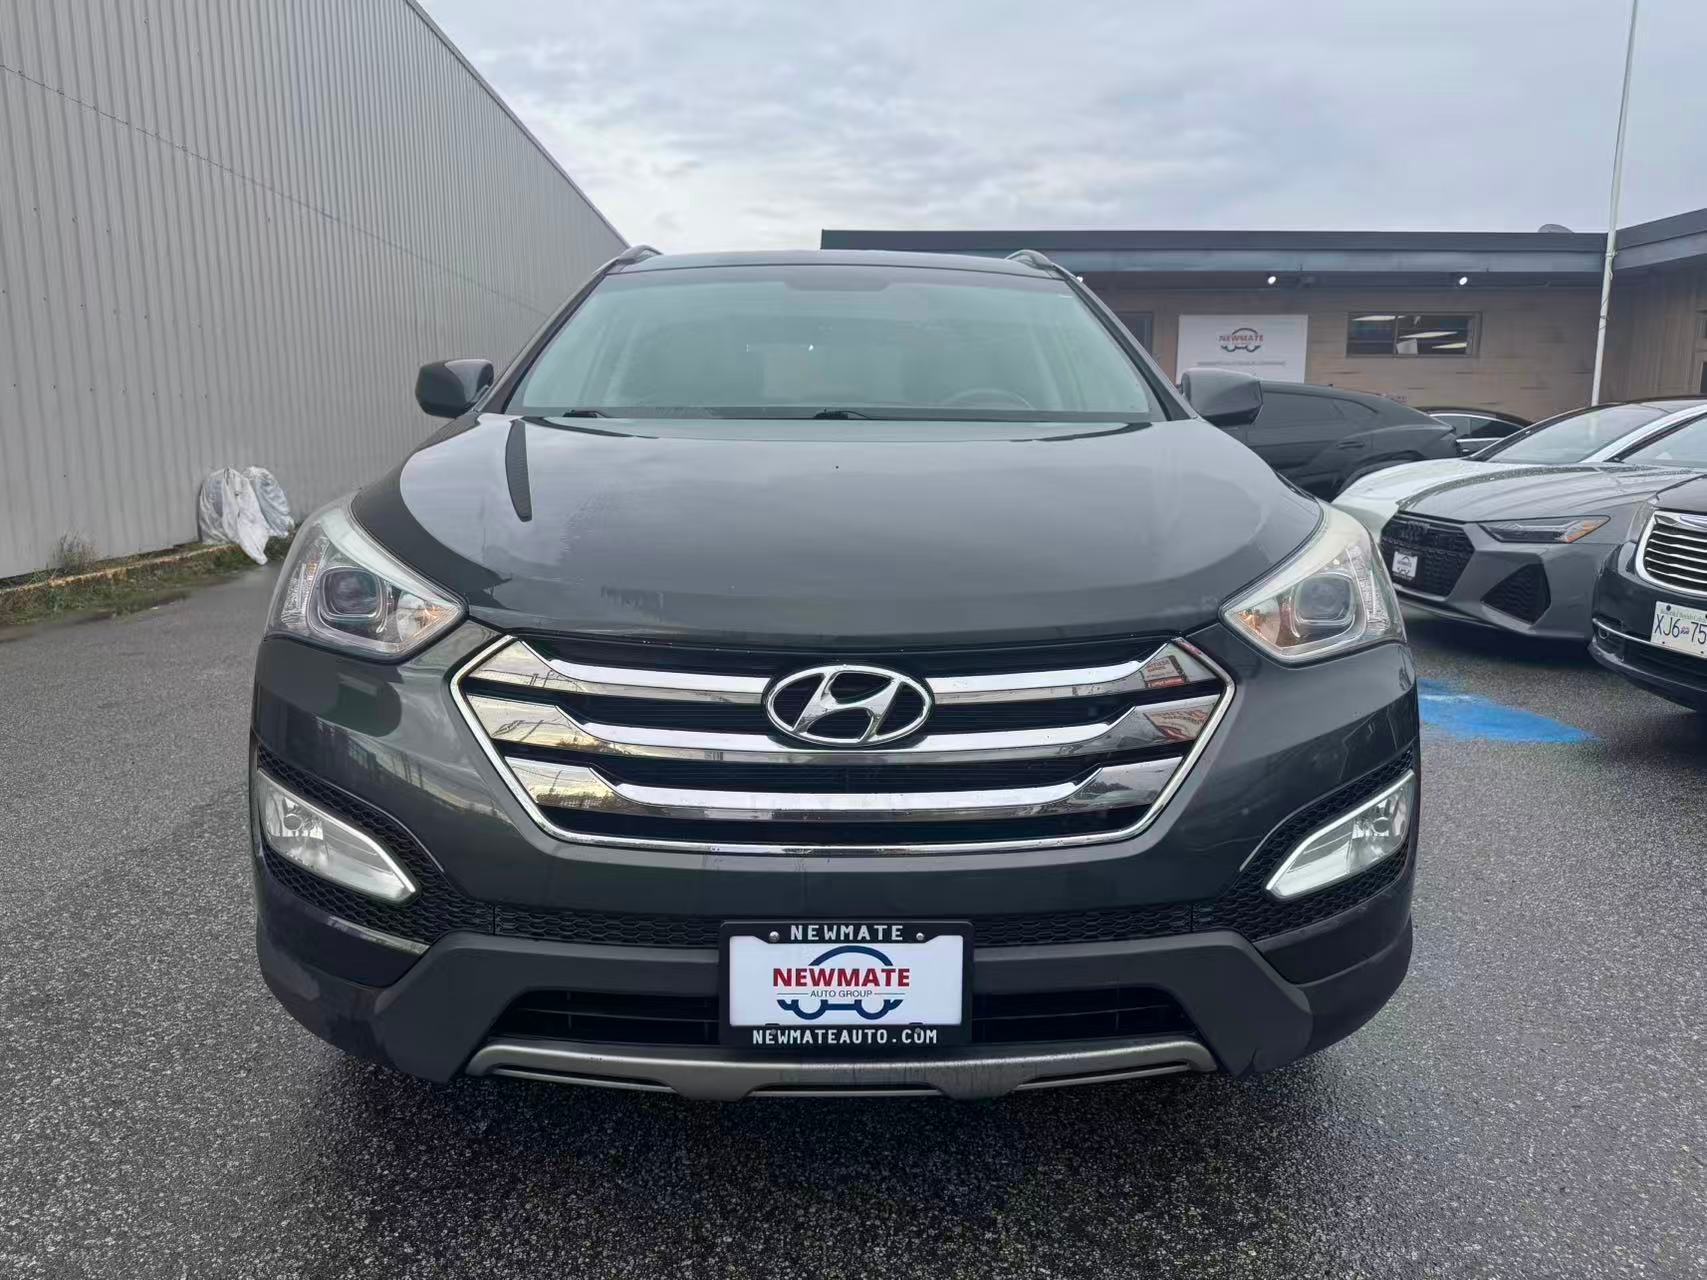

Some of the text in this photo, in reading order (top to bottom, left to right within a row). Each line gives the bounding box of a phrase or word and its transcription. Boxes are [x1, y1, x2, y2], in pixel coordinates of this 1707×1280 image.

[1218, 334, 1264, 343] NEWMATE
[1654, 613, 1681, 638] XJ6
[790, 924, 904, 941] NEWMATE
[773, 967, 911, 987] NEWMATE
[810, 989, 873, 998] AUTO GROUP
[752, 1028, 938, 1045] NEWMATEAUTO.COM
